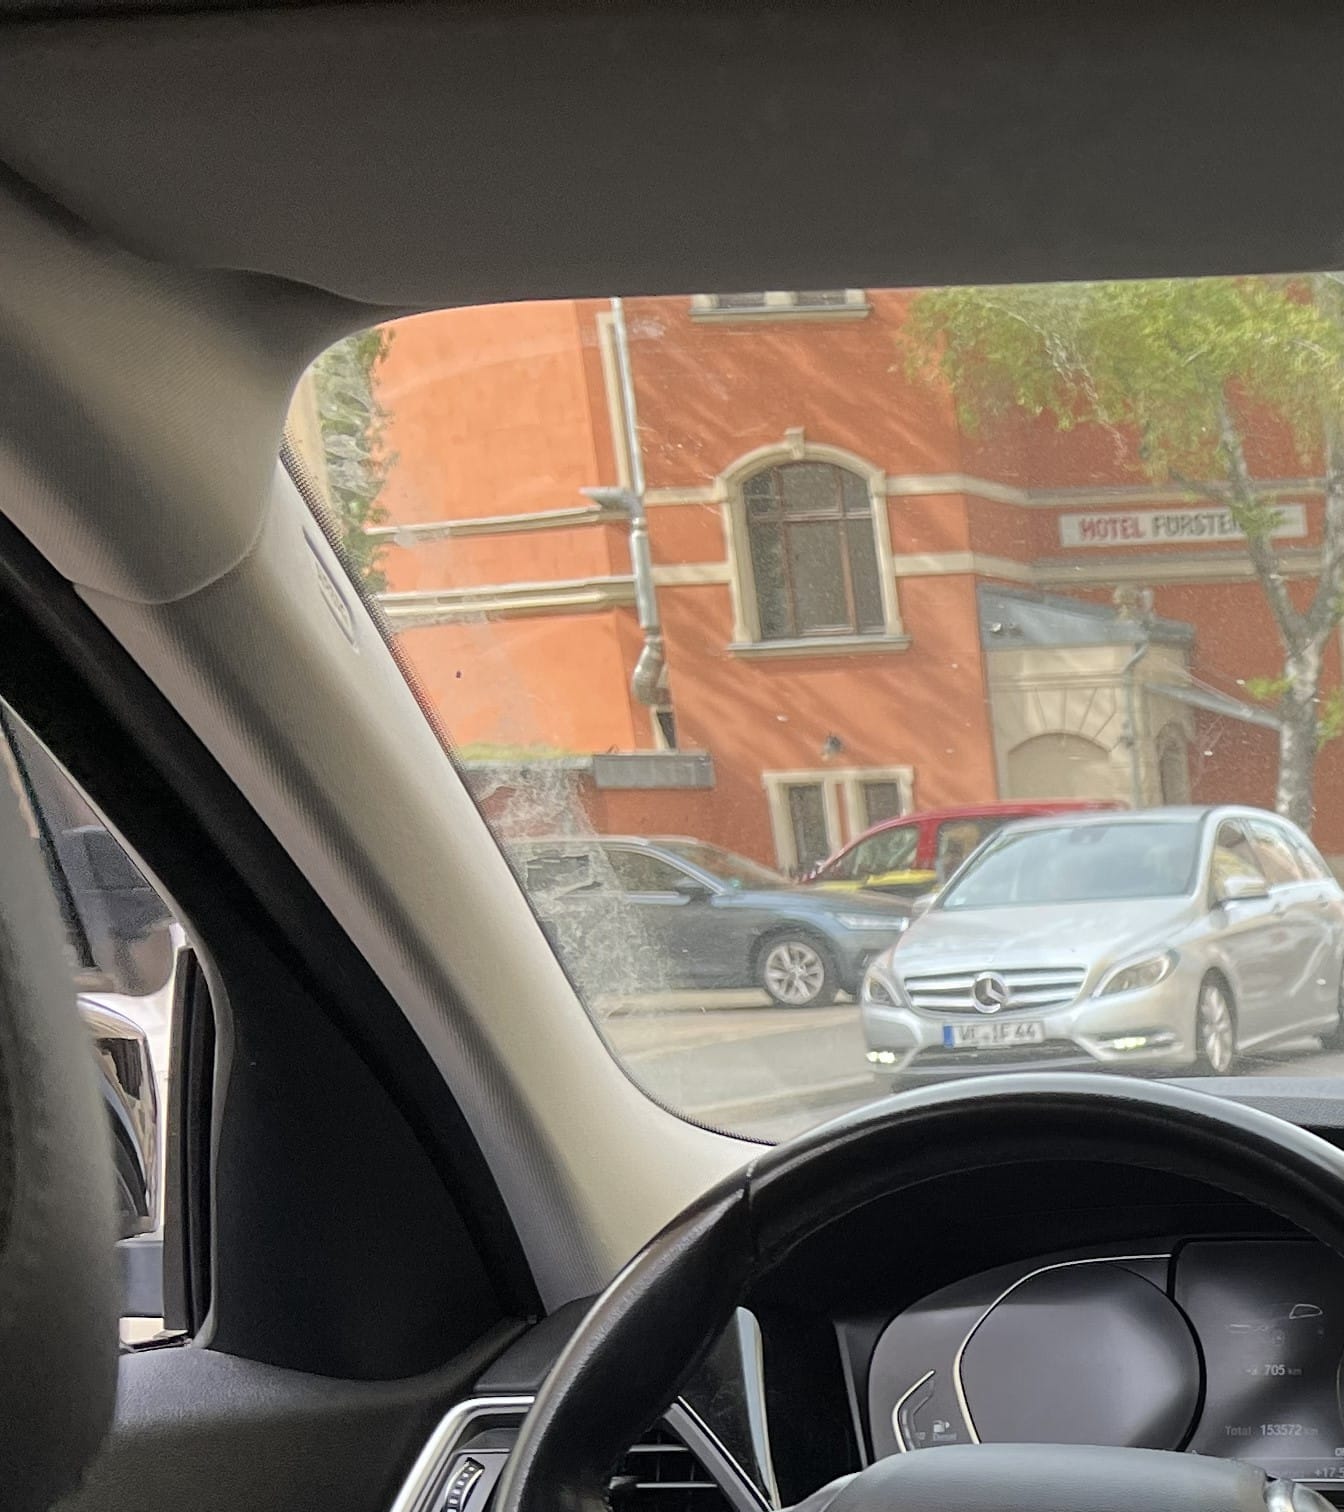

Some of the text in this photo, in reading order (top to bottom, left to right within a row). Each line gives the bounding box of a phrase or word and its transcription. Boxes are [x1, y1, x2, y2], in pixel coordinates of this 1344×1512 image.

[1079, 516, 1144, 540] HOTEL
[1264, 1364, 1286, 1376] 705
[1260, 1424, 1302, 1437] 153572
